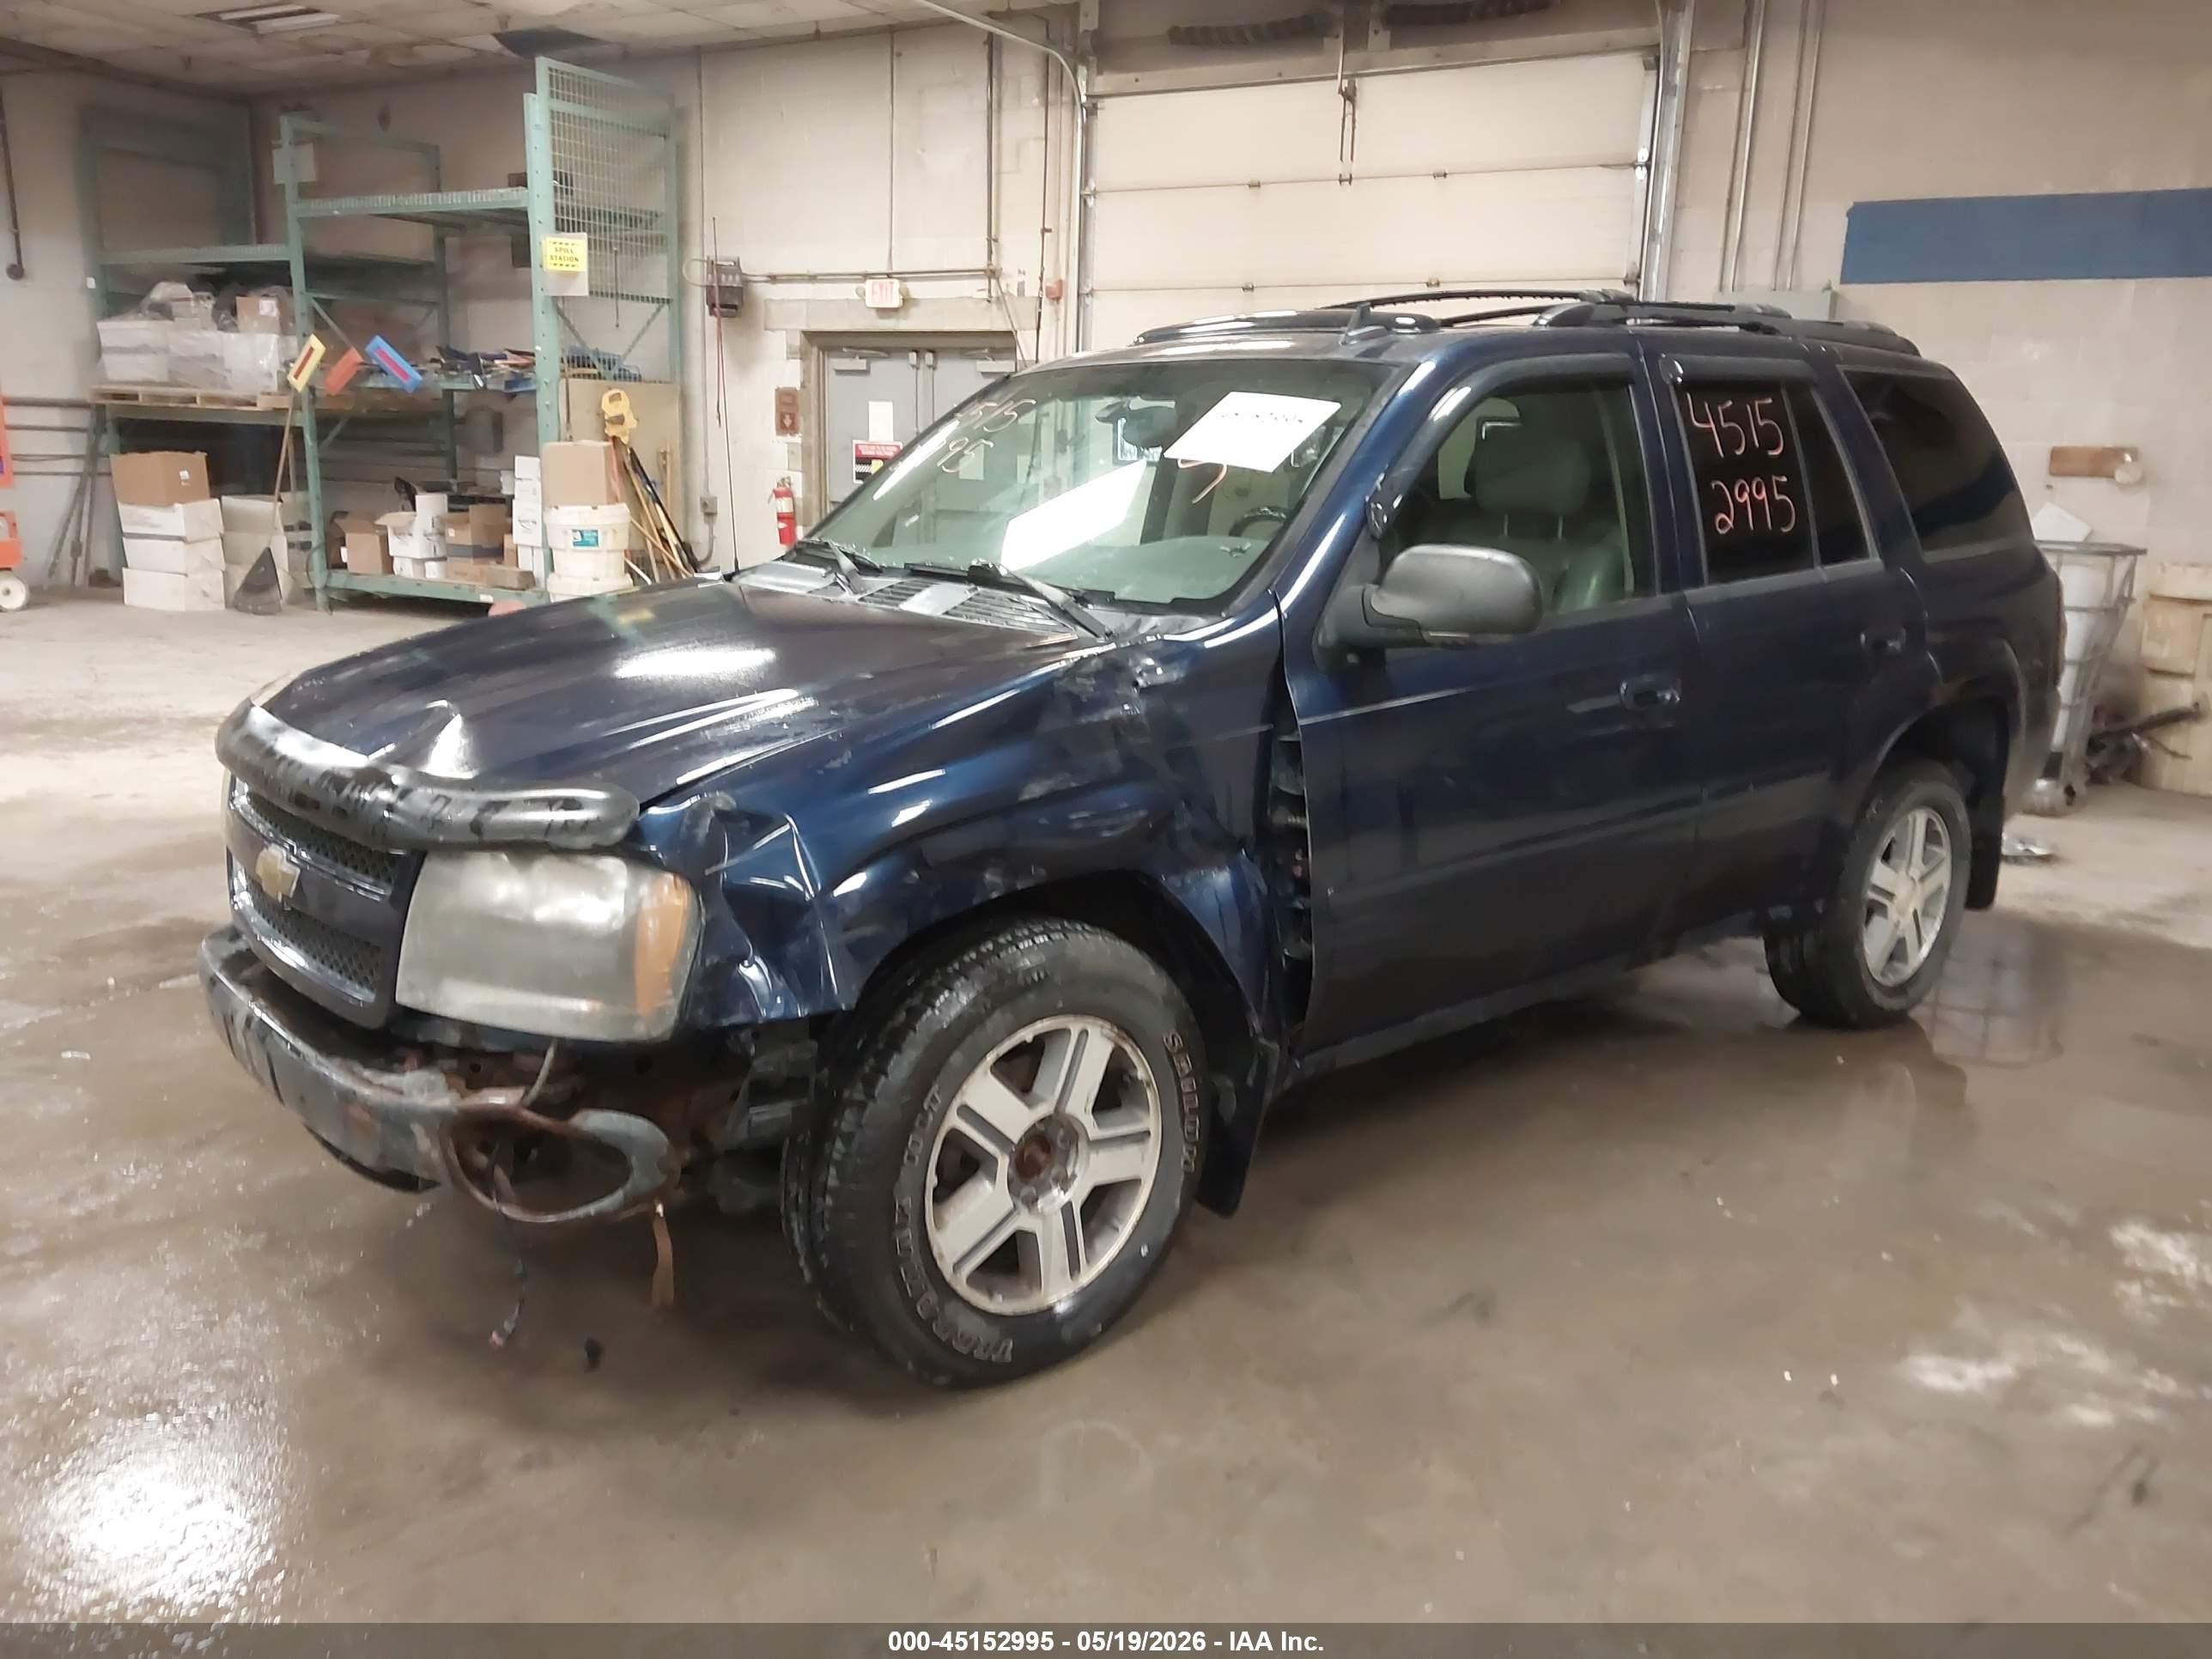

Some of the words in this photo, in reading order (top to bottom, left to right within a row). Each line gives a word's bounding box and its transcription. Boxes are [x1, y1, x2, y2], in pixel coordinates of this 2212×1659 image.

[549, 254, 580, 263] STATION
[554, 246, 574, 255] SPILL
[871, 281, 895, 304] EXIT
[954, 398, 1037, 433] 515
[1686, 392, 1784, 459] 4515
[1711, 475, 1796, 535] 2995
